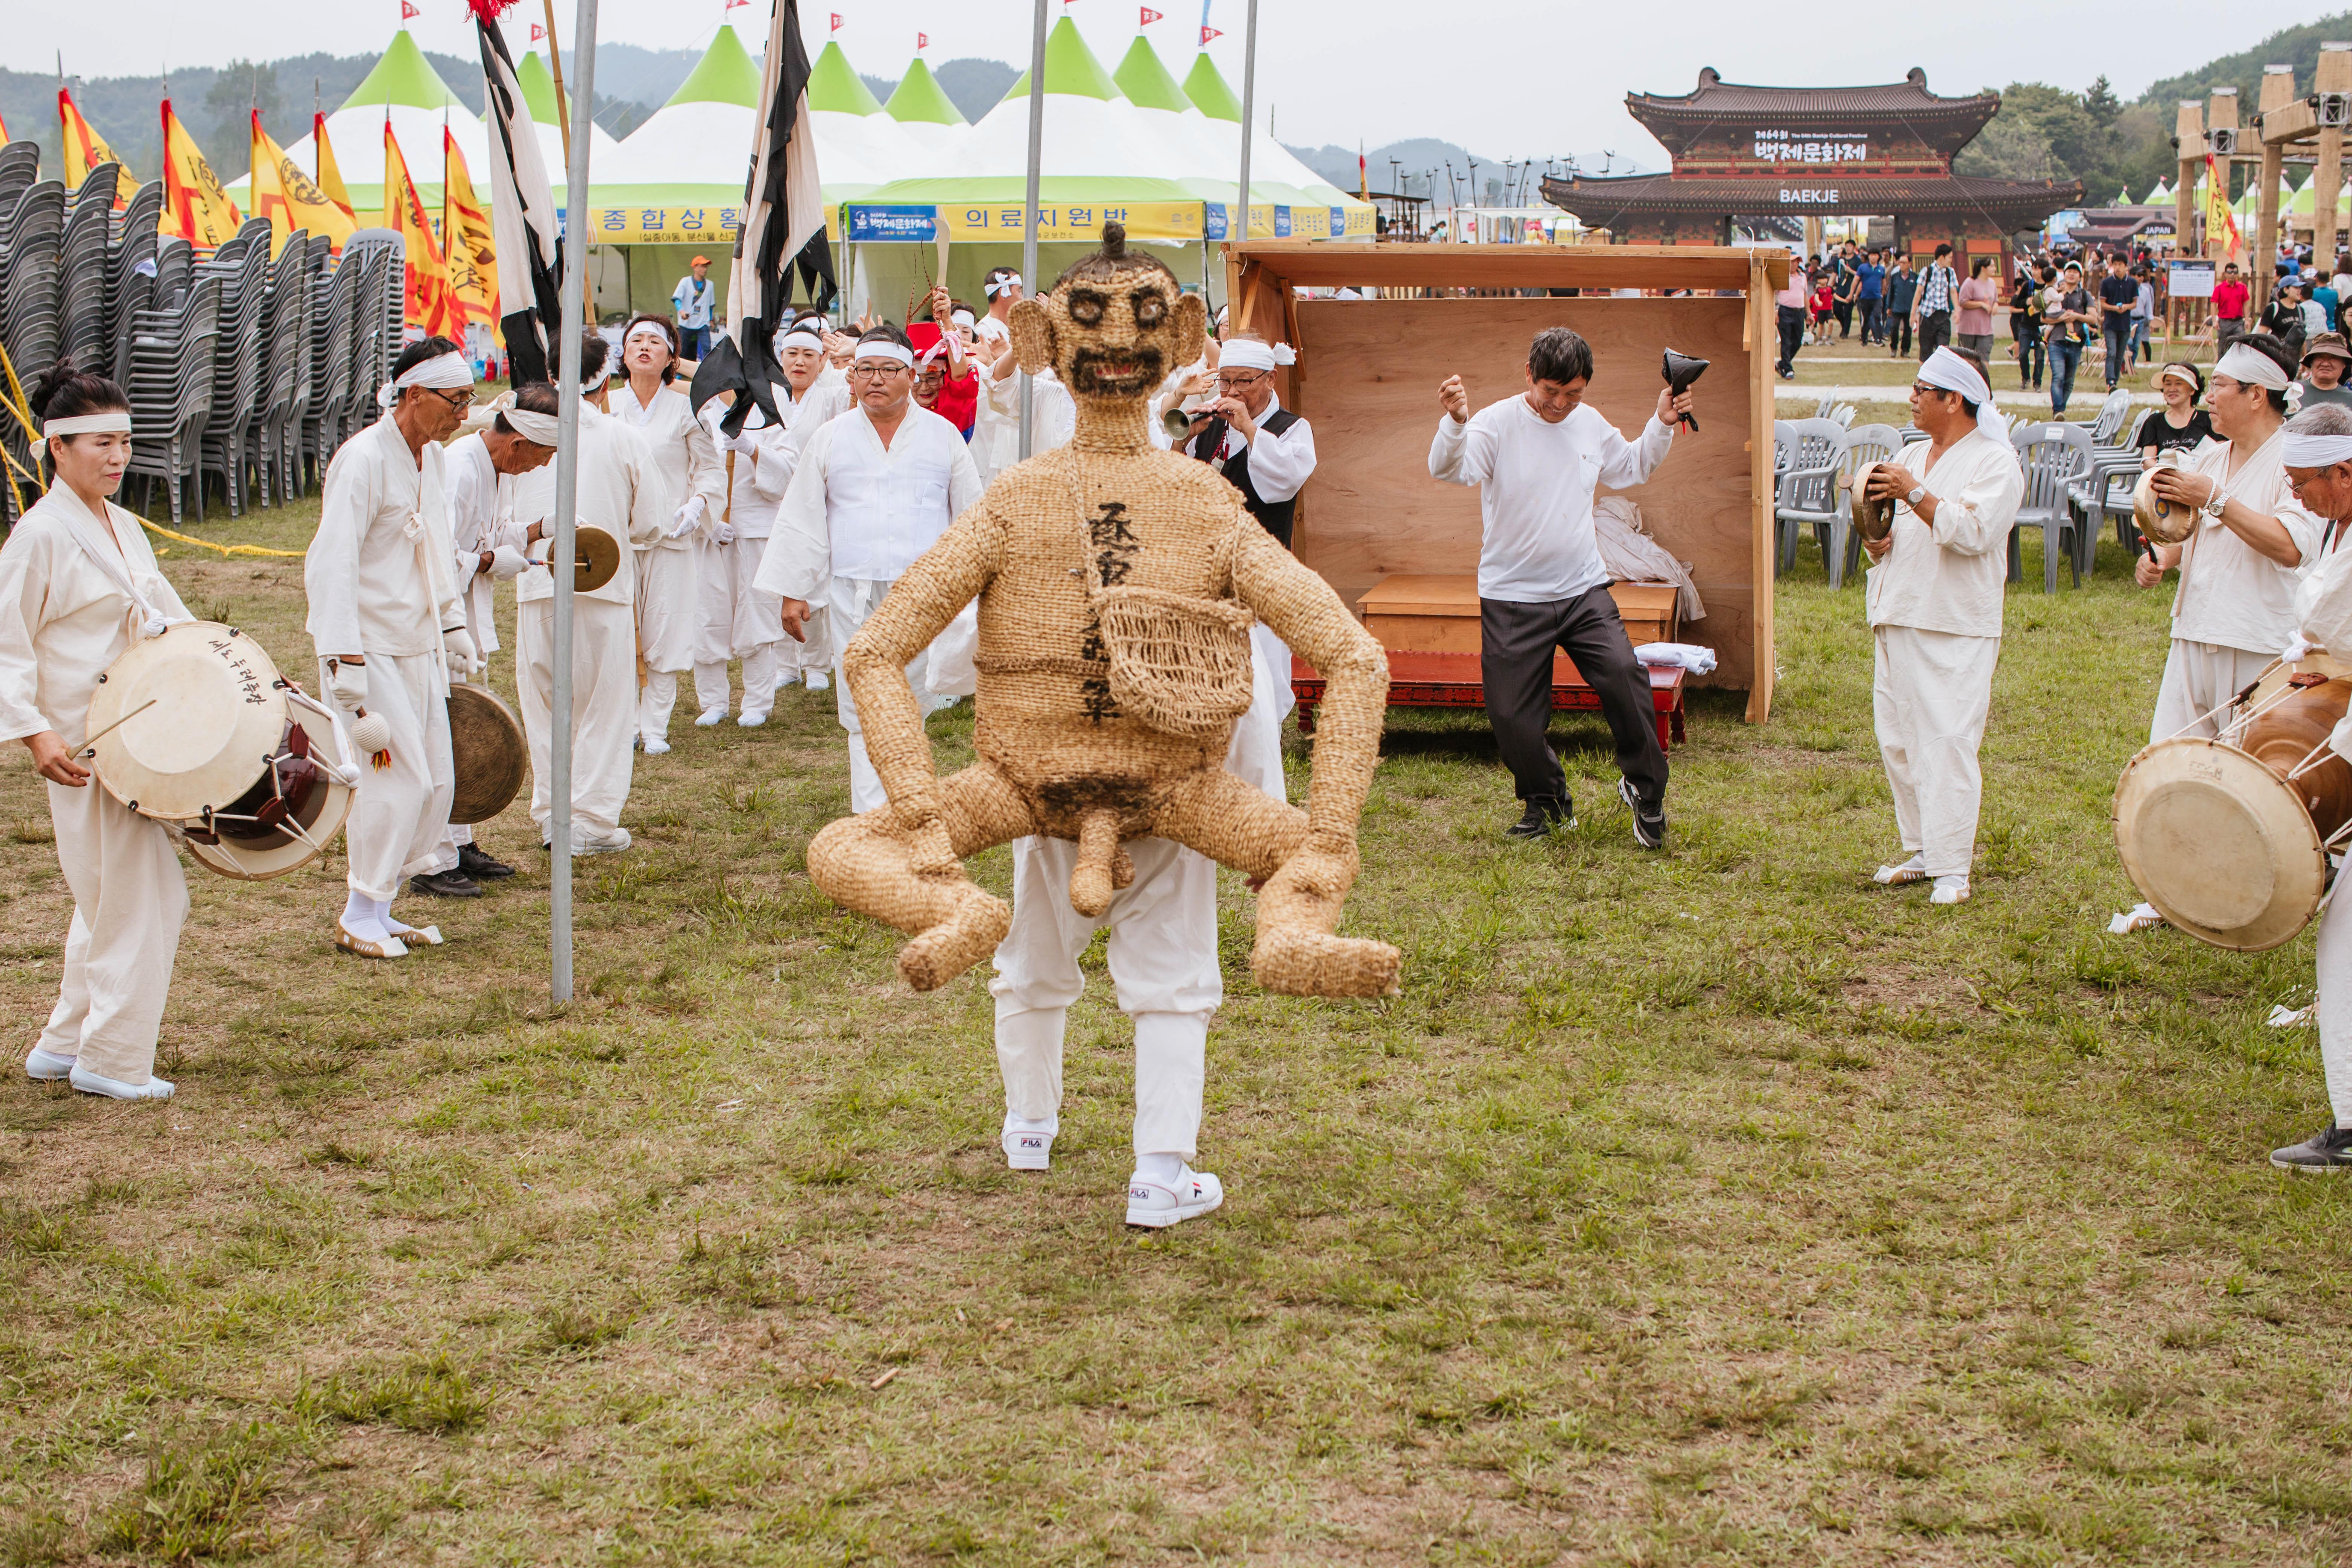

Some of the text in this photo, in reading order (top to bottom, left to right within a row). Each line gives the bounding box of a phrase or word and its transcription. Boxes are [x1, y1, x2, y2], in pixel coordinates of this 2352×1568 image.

[1755, 130, 1788, 139] 제64회
[1754, 142, 1866, 163] 백제문화제
[1779, 189, 1839, 203] BAEKJE
[603, 209, 741, 231] 종합상황
[870, 218, 927, 229] 백제문화제
